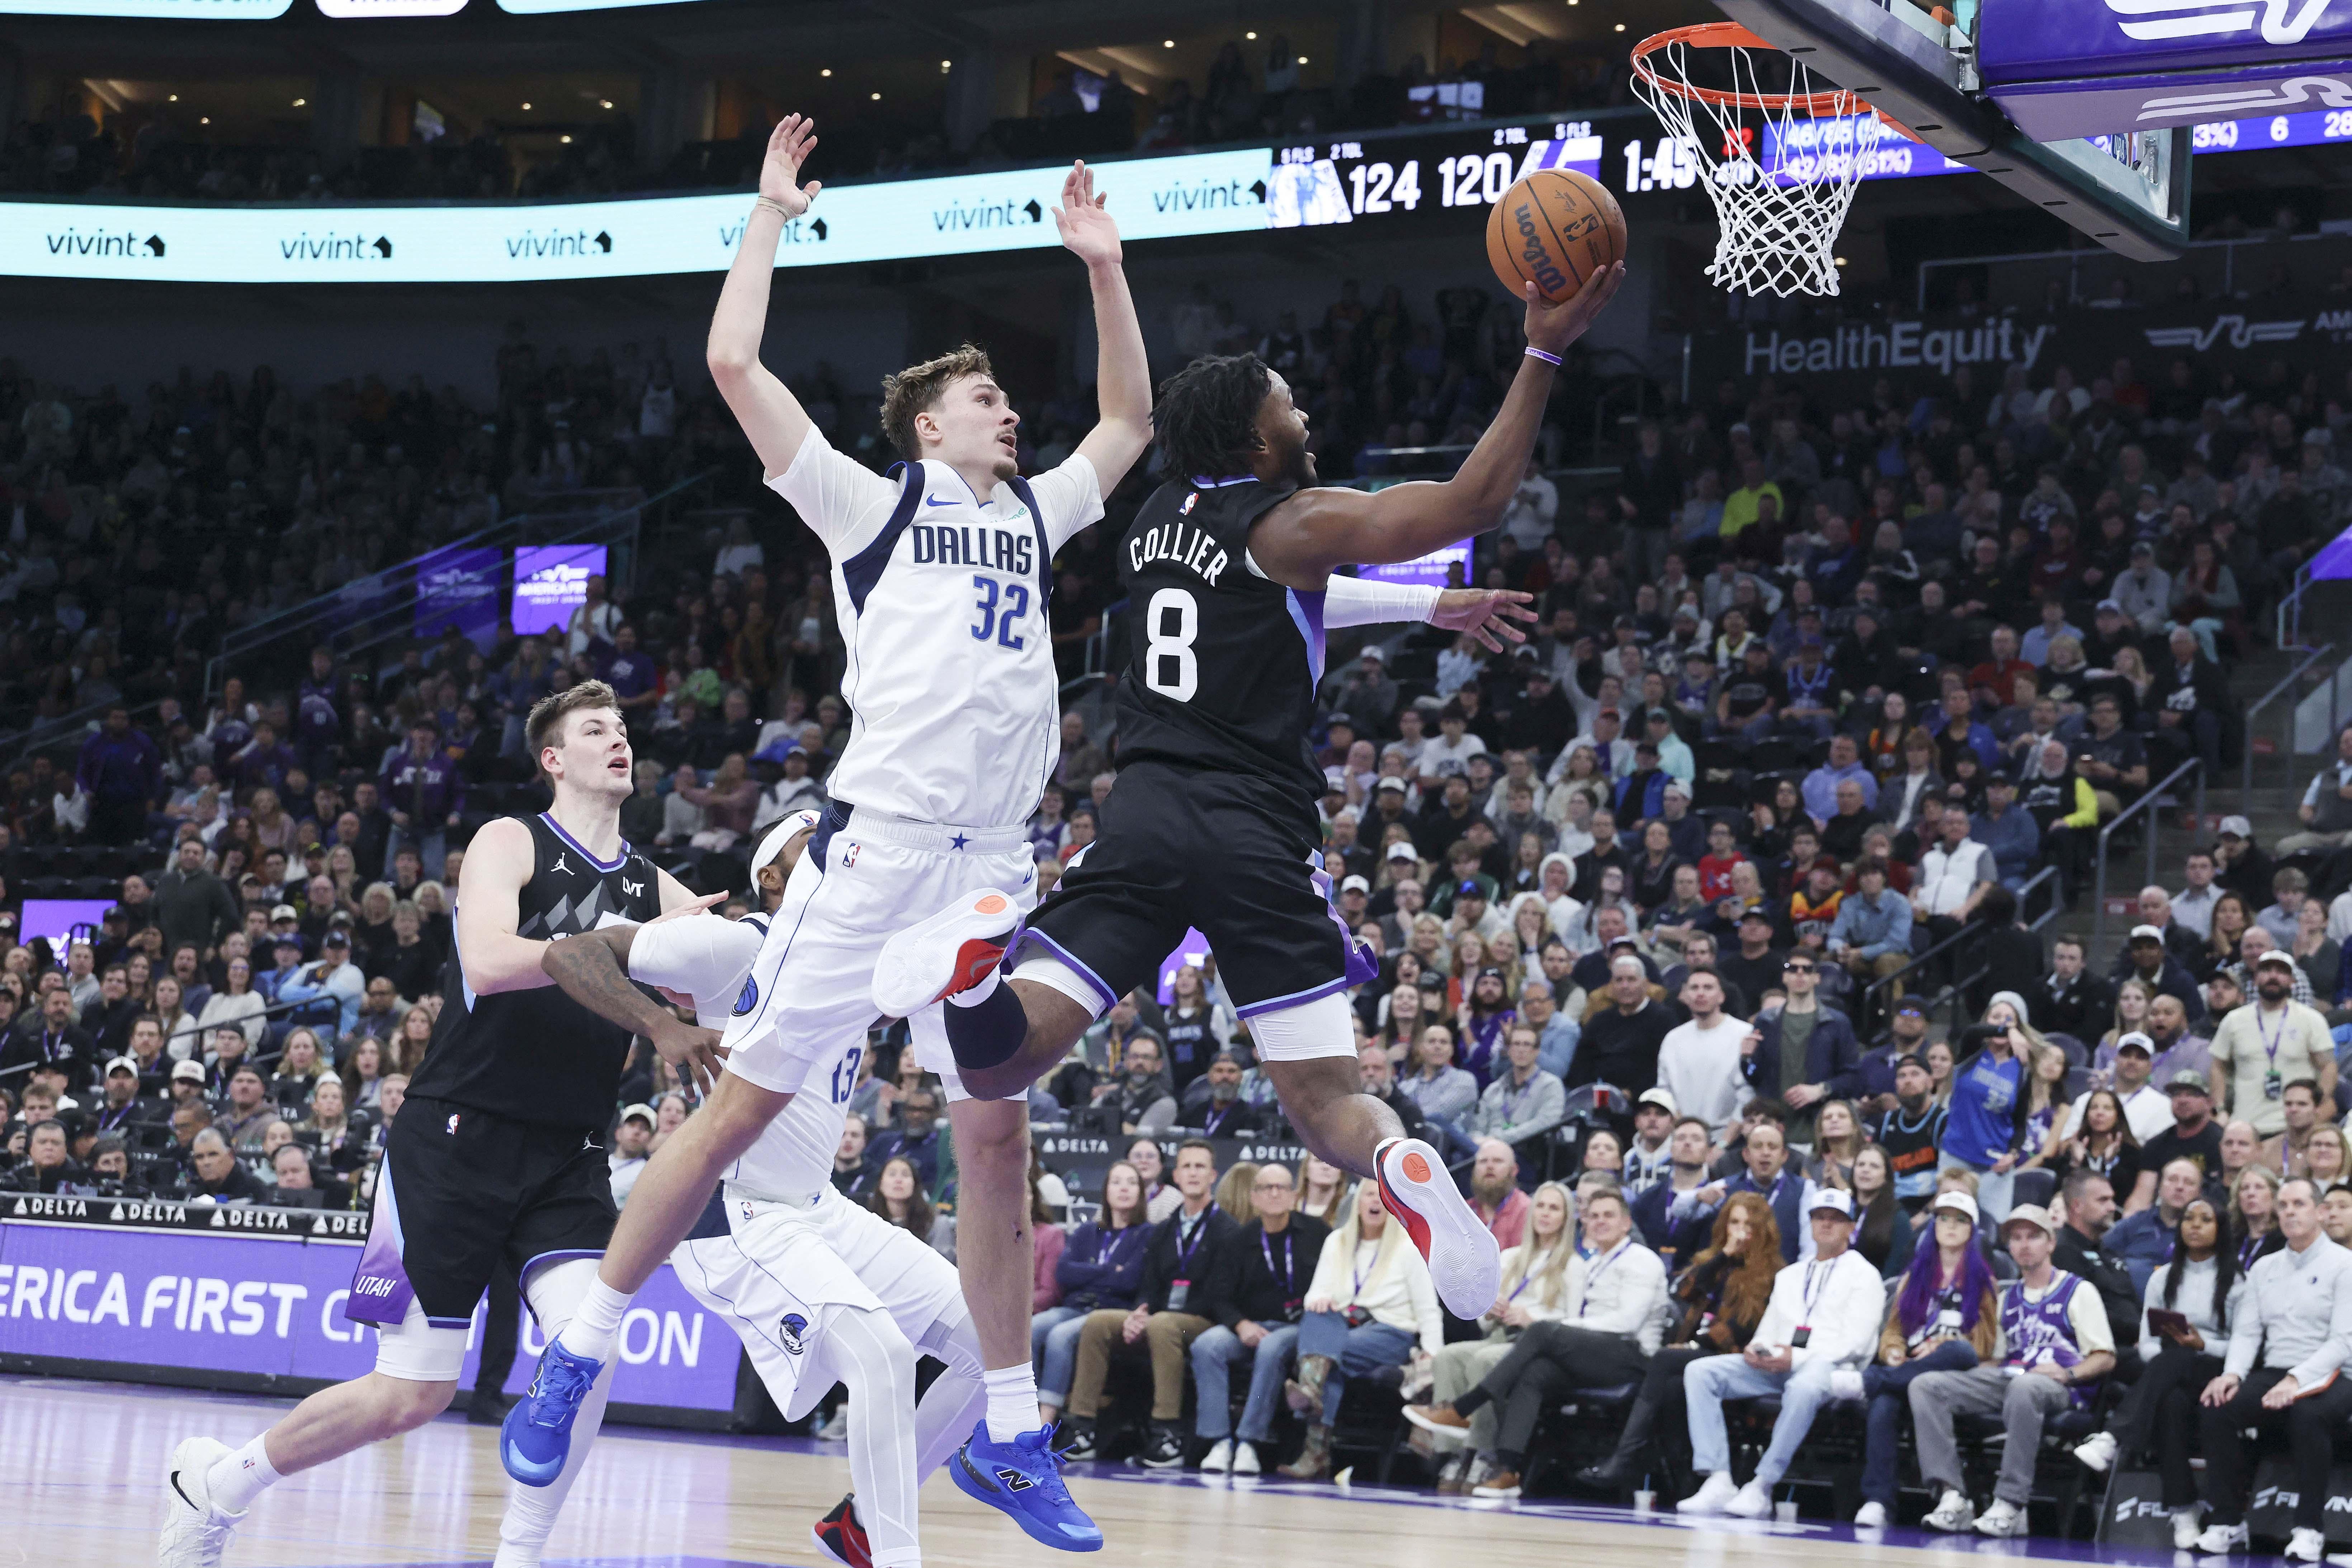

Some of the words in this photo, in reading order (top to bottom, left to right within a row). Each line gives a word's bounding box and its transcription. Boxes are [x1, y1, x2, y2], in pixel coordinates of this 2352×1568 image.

[2270, 116, 2289, 142] 6
[1624, 135, 1697, 193] 1:45
[1349, 160, 1422, 215] 124
[1438, 152, 1513, 208] 120
[1154, 181, 1241, 212] vivint
[932, 201, 1019, 233] vivint
[46, 227, 138, 259] vivint
[280, 231, 364, 261] vivint
[506, 228, 588, 259] vivint
[719, 219, 803, 247] vint
[1515, 202, 1567, 294] Wilson
[1744, 317, 2046, 375] HealthEquity
[912, 525, 1033, 576] DALLAS
[1129, 523, 1228, 587] COLLIER
[970, 574, 1029, 652] 32
[1146, 588, 1198, 703] 8
[631, 854, 645, 866] FRA
[832, 1047, 861, 1104] 13
[1057, 1138, 1110, 1154] DELTA
[1256, 1145, 1308, 1161] DELTA
[31, 1199, 88, 1217] DELTA
[128, 1203, 186, 1223] DELTA
[229, 1209, 289, 1229] DELTA
[331, 1216, 368, 1235] DEL
[355, 1276, 397, 1298] UTAH
[140, 1275, 308, 1338] FIRST
